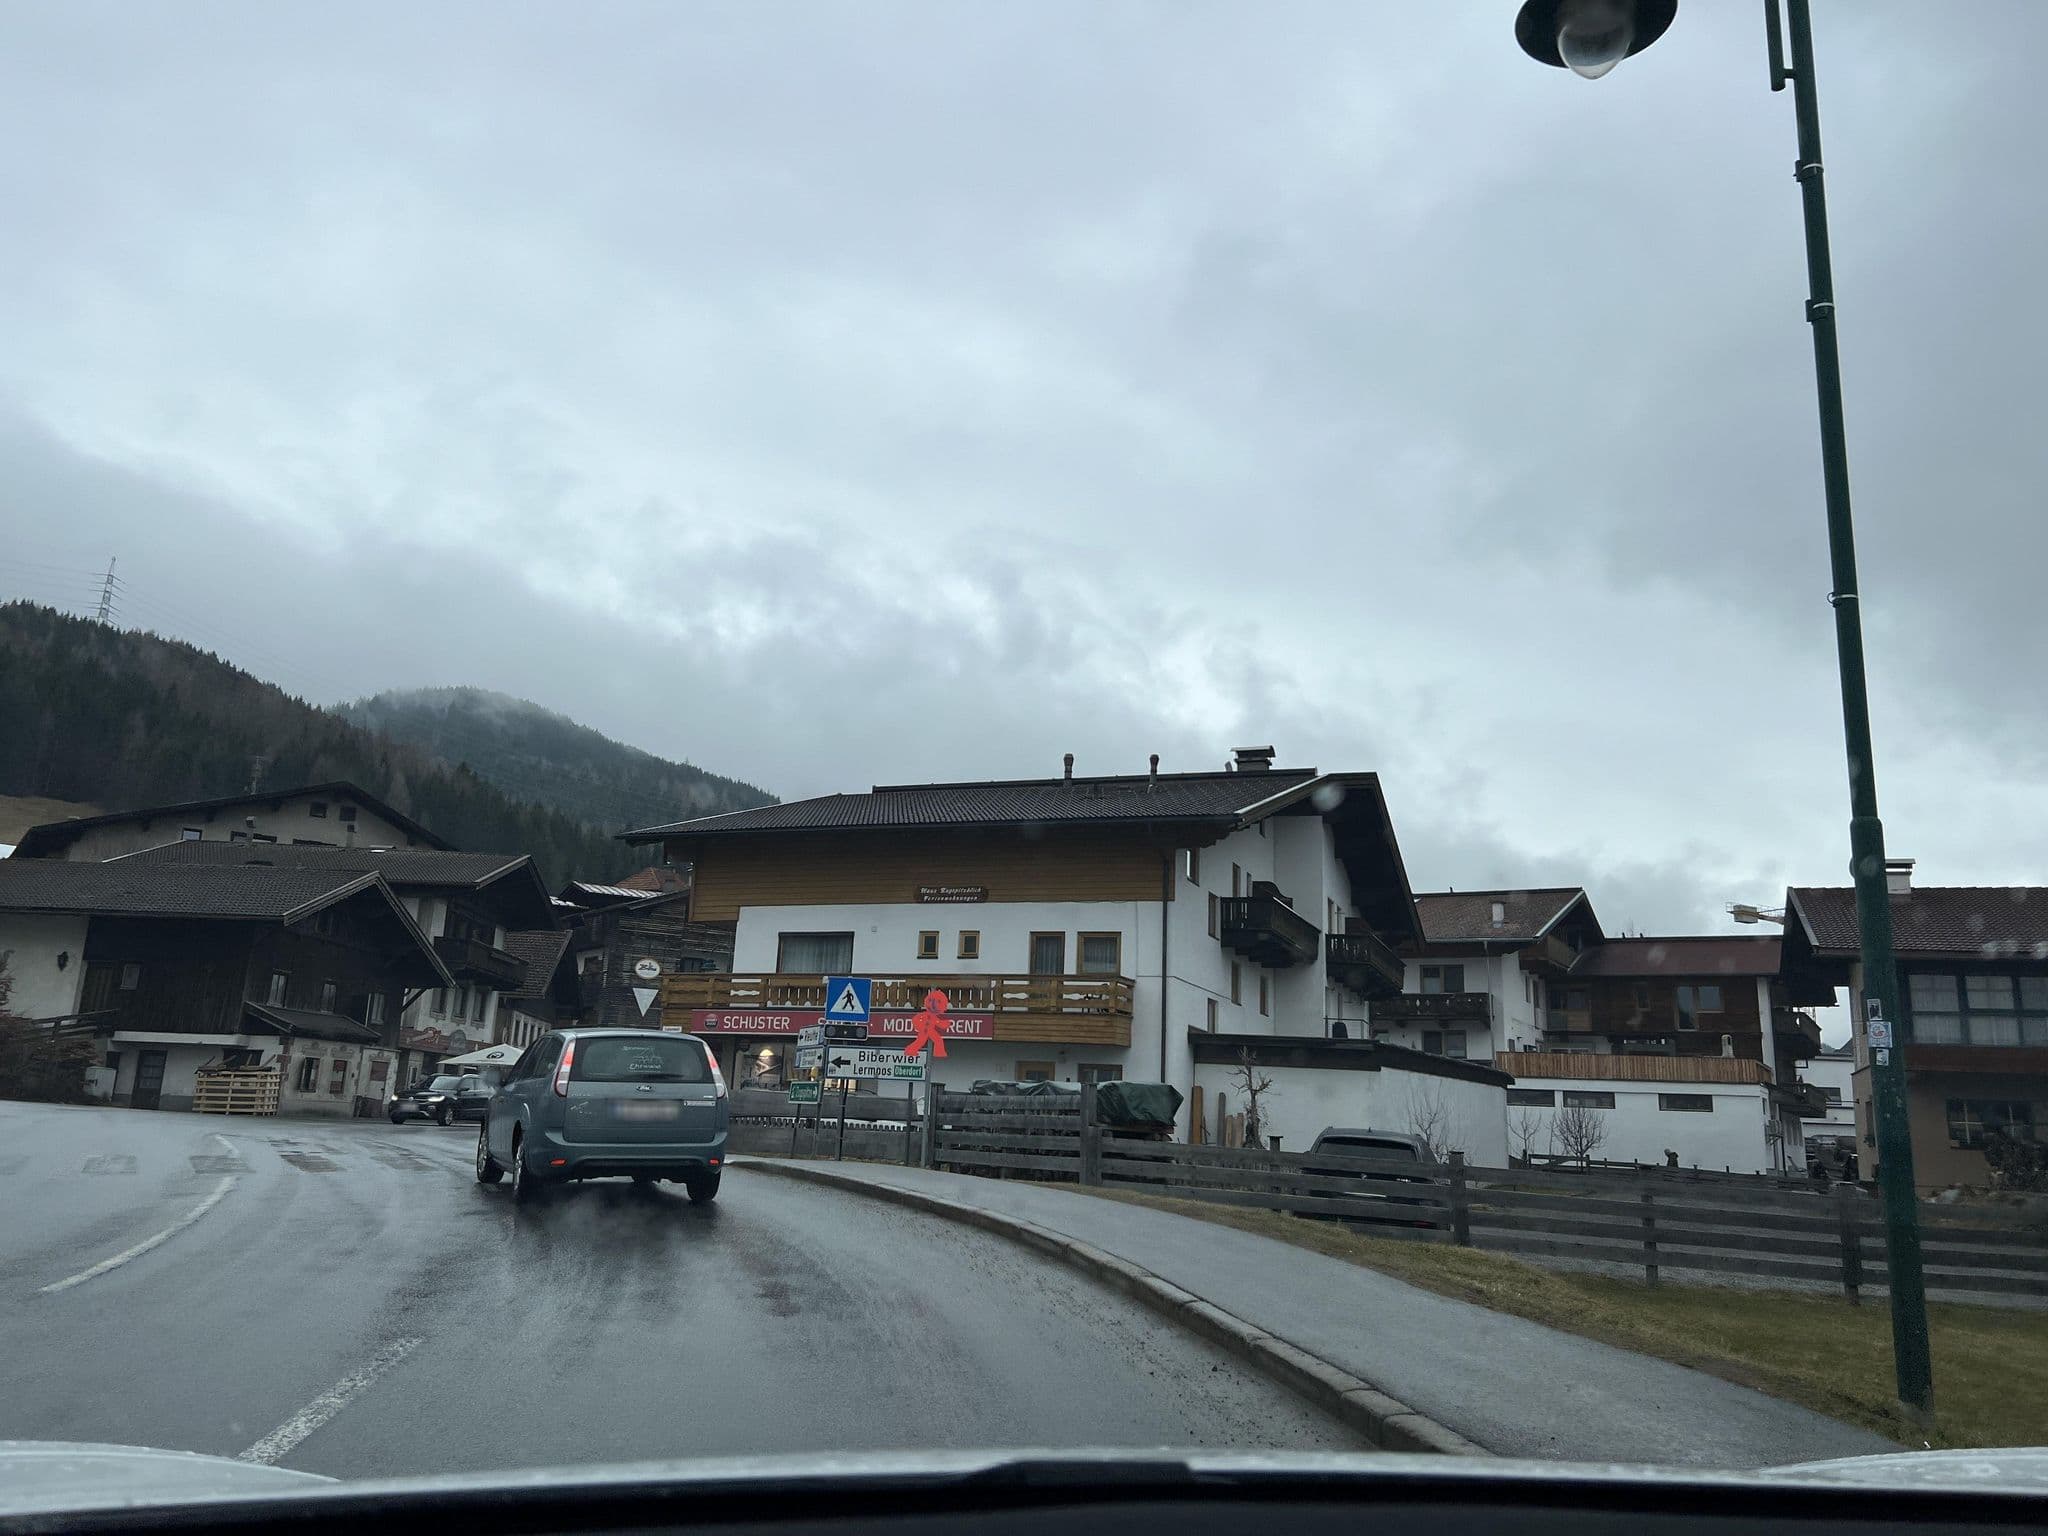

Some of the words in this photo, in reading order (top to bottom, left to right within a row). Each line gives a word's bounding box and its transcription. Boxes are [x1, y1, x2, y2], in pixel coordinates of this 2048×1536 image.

[723, 1016, 790, 1030] SCHUSTER
[884, 1018, 919, 1033] MOD
[946, 1019, 983, 1034] RENT
[858, 1050, 920, 1064] Biberwier
[853, 1064, 892, 1076] Lermoos
